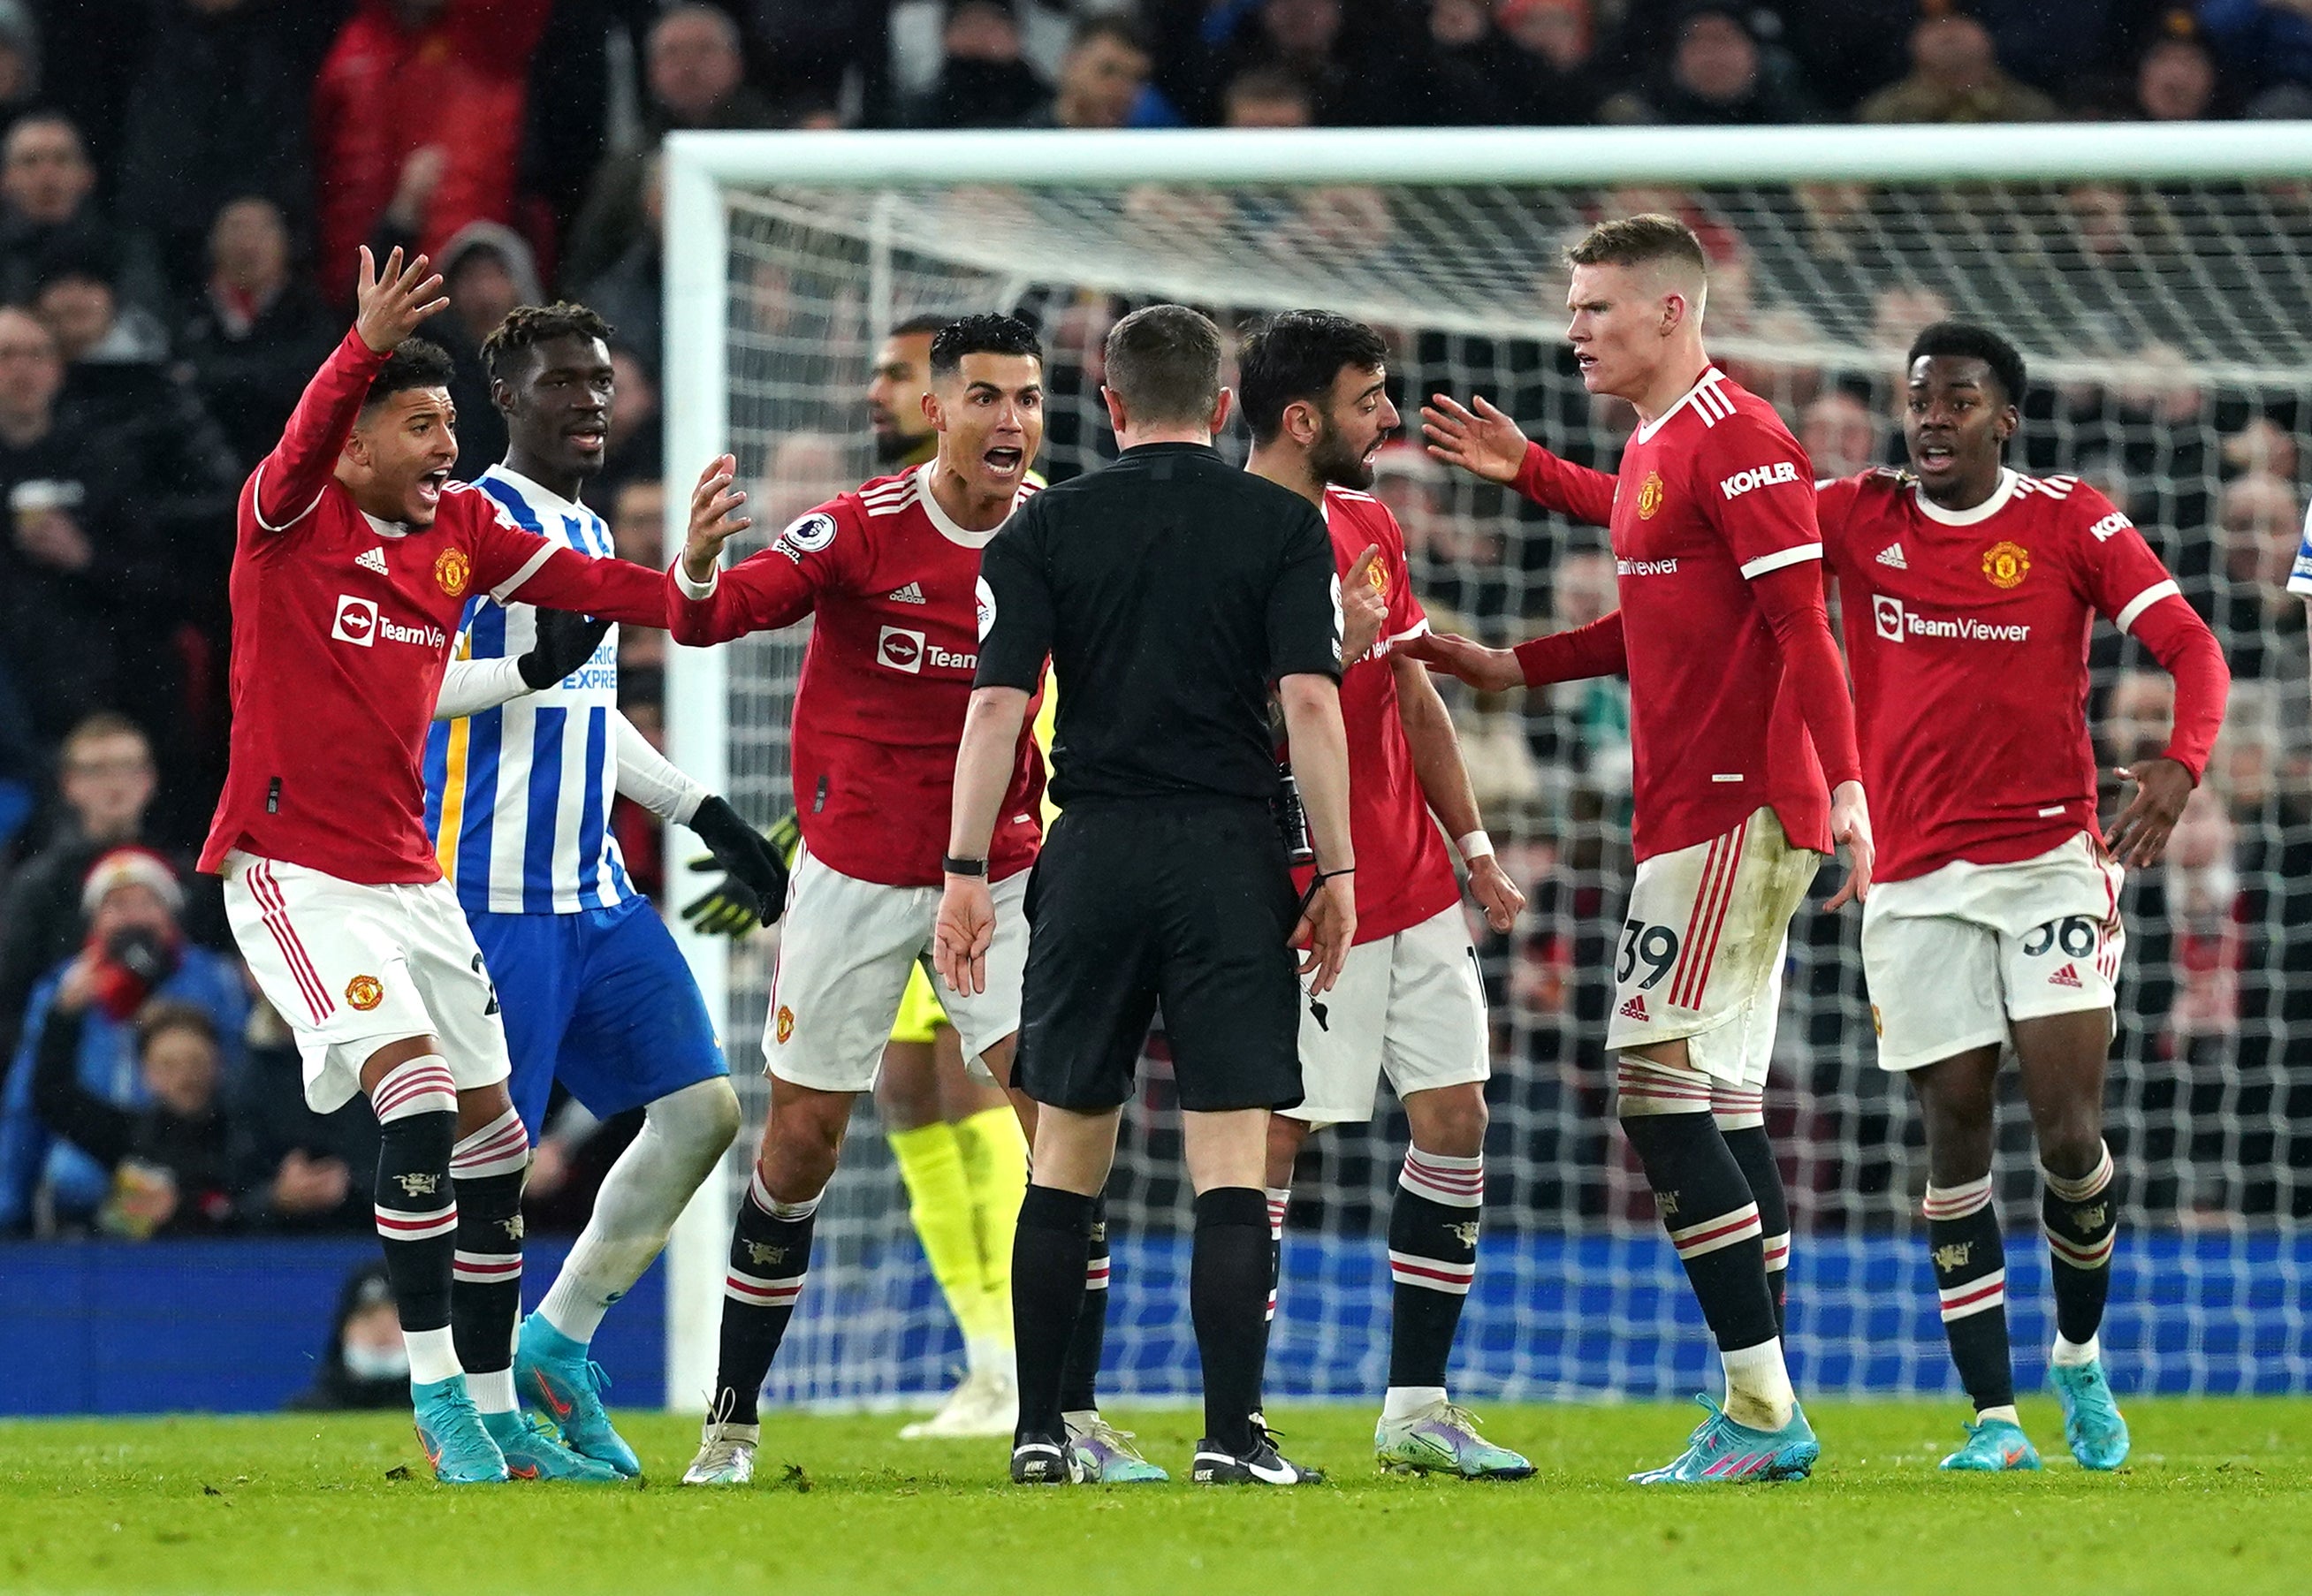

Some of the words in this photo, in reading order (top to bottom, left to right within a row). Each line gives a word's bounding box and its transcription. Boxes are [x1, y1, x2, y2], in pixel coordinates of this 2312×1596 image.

[1720, 461, 1799, 500] KOHLER
[354, 556, 389, 575] adidas
[1875, 554, 1908, 570] adidas
[889, 592, 926, 604] adidas
[1905, 612, 2030, 642] TeamViewer
[1616, 919, 1678, 990] 39
[2048, 977, 2083, 989] adidas
[1619, 1007, 1650, 1022] adidas
